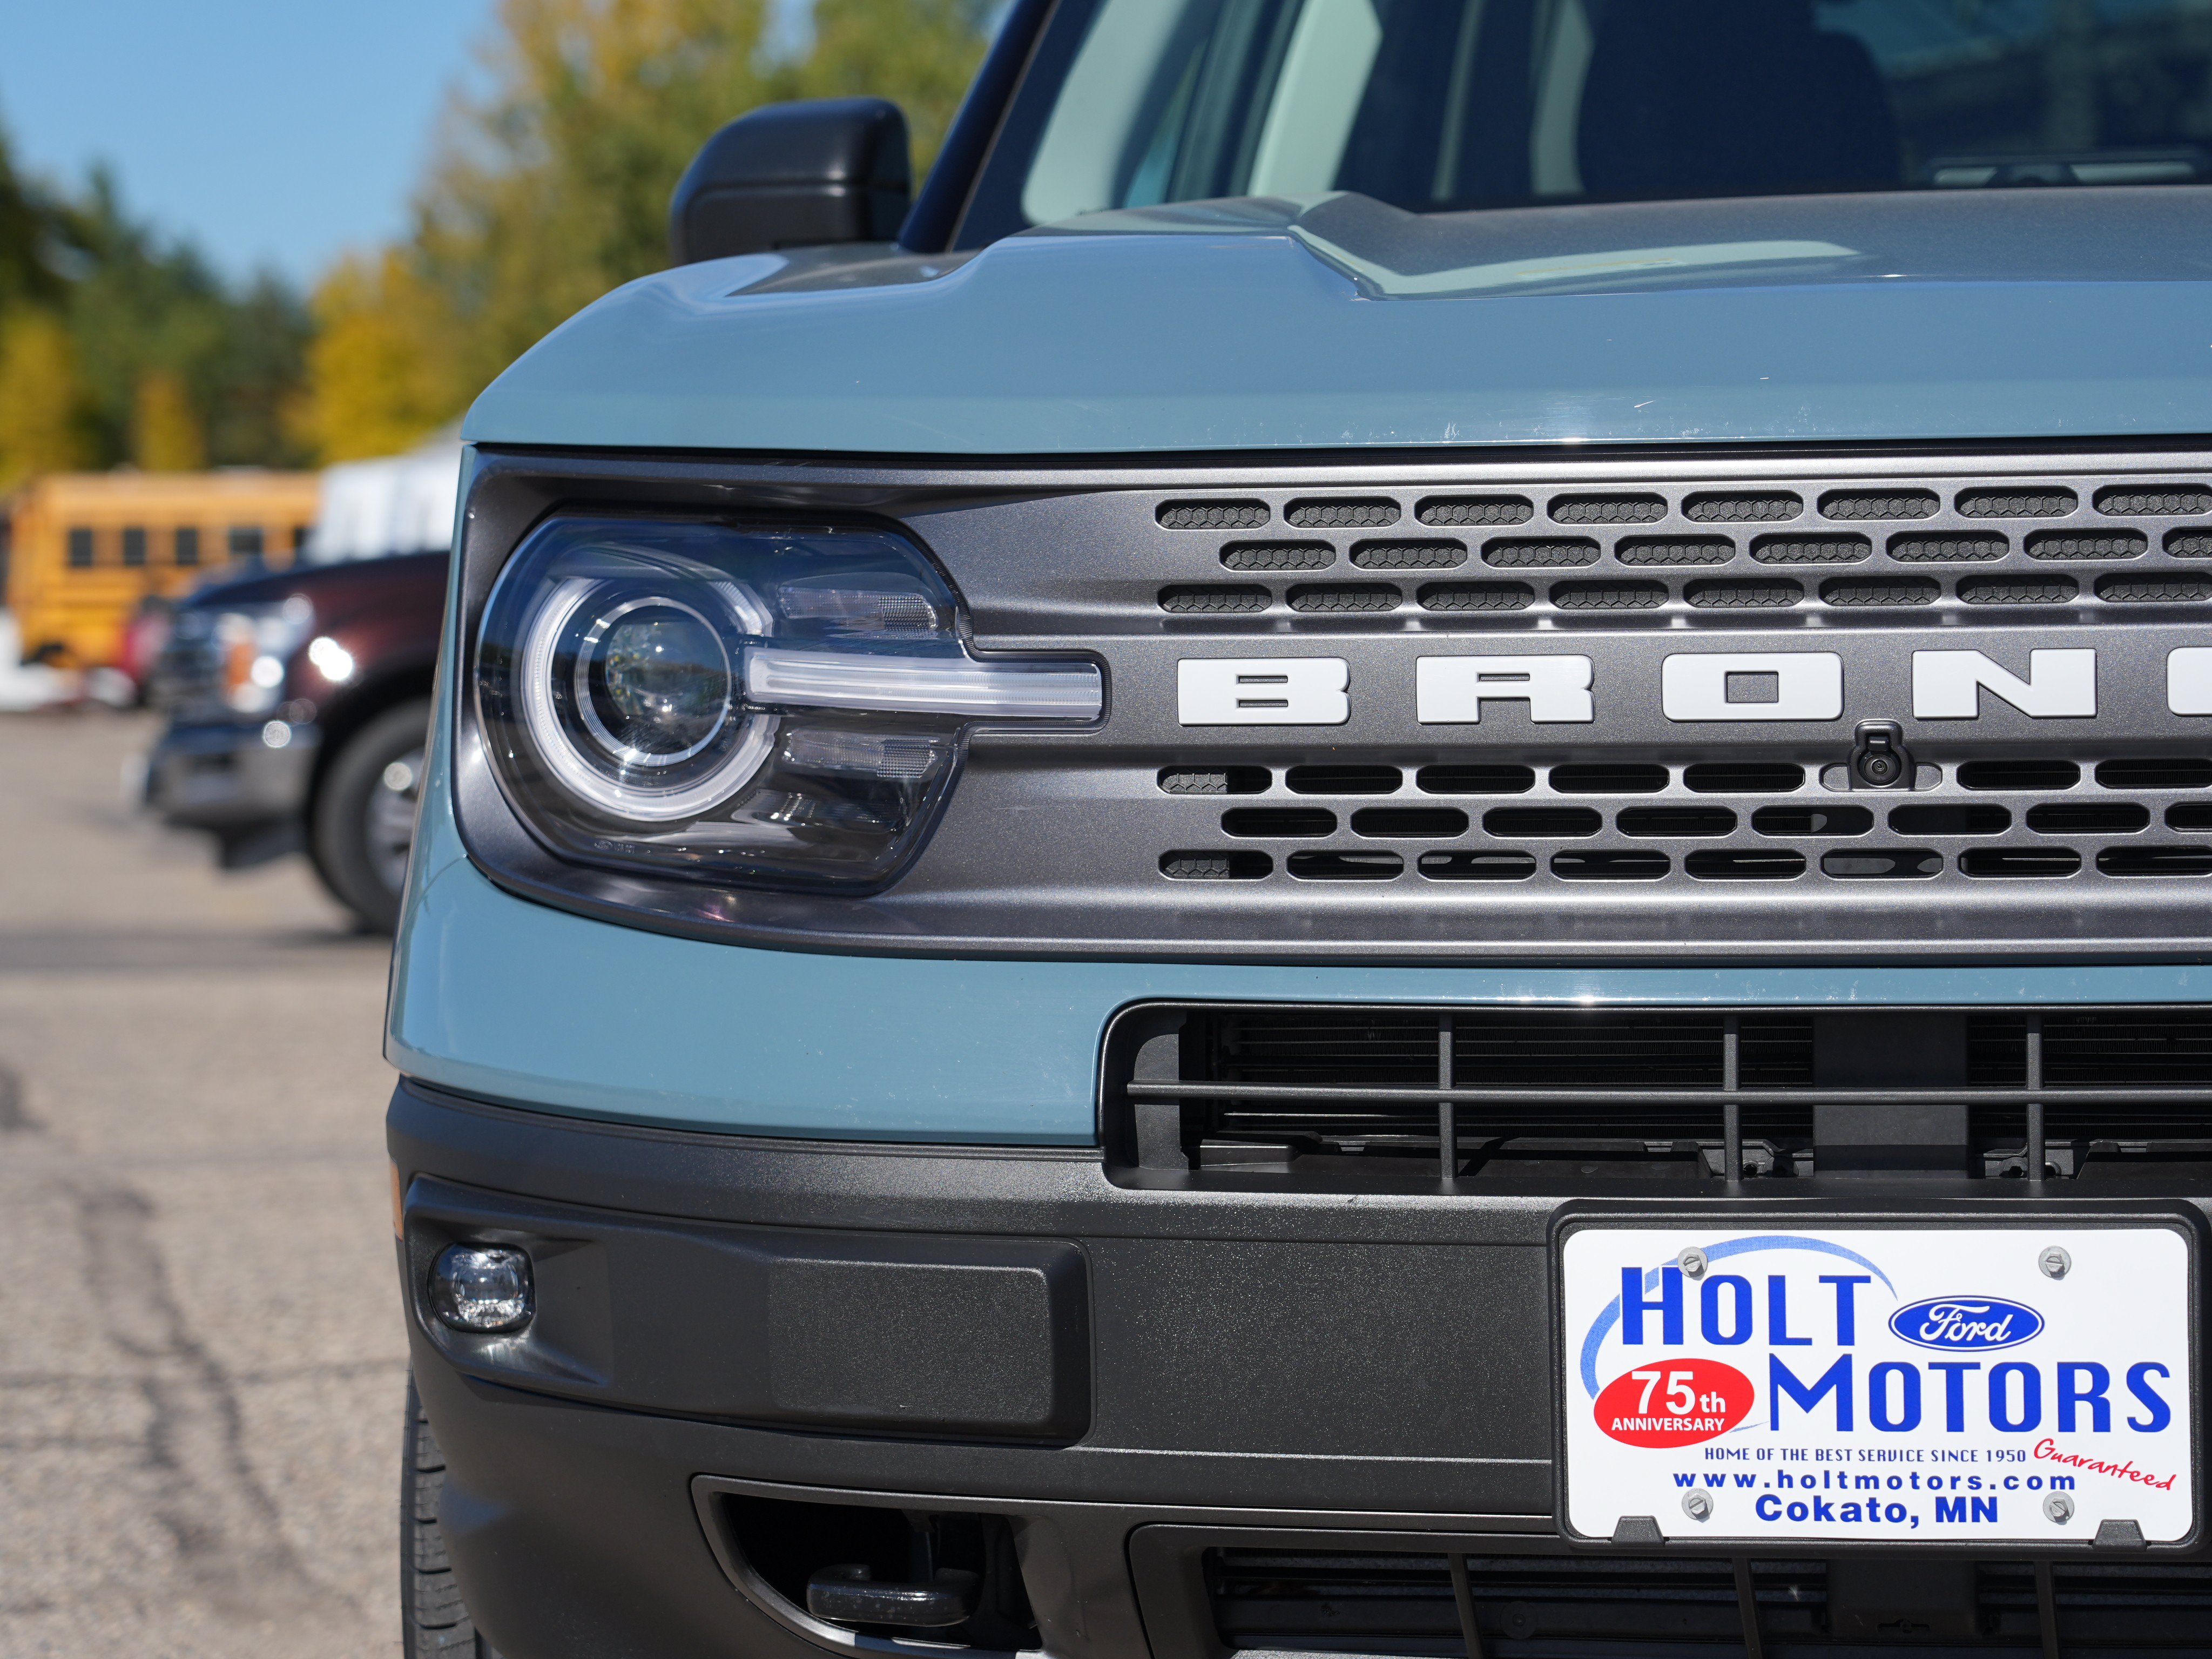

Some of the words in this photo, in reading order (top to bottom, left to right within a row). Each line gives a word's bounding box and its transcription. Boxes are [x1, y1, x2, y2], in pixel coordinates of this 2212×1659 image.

[1177, 647, 2212, 727] BRON
[1622, 1267, 1871, 1346] HOLT
[1919, 1304, 2014, 1341] Ford
[1631, 1371, 1727, 1415] 75th
[1769, 1353, 2171, 1433] MOTORS
[1611, 1417, 1725, 1432] ANNIVERSARY
[1704, 1447, 1750, 1460] HOME
[1756, 1448, 1775, 1460] OF
[1781, 1448, 1809, 1461] THE
[1815, 1449, 1853, 1462] BEST
[1858, 1449, 1925, 1462] SERVICE
[1931, 1449, 1979, 1462] SINCE
[1986, 1449, 2026, 1462] 1950
[2034, 1438, 2177, 1491] Guaranteed
[1673, 1469, 2076, 1491] www.holtmotors.com
[1756, 1494, 1919, 1529] Cokato,
[1935, 1495, 1998, 1523] MN
